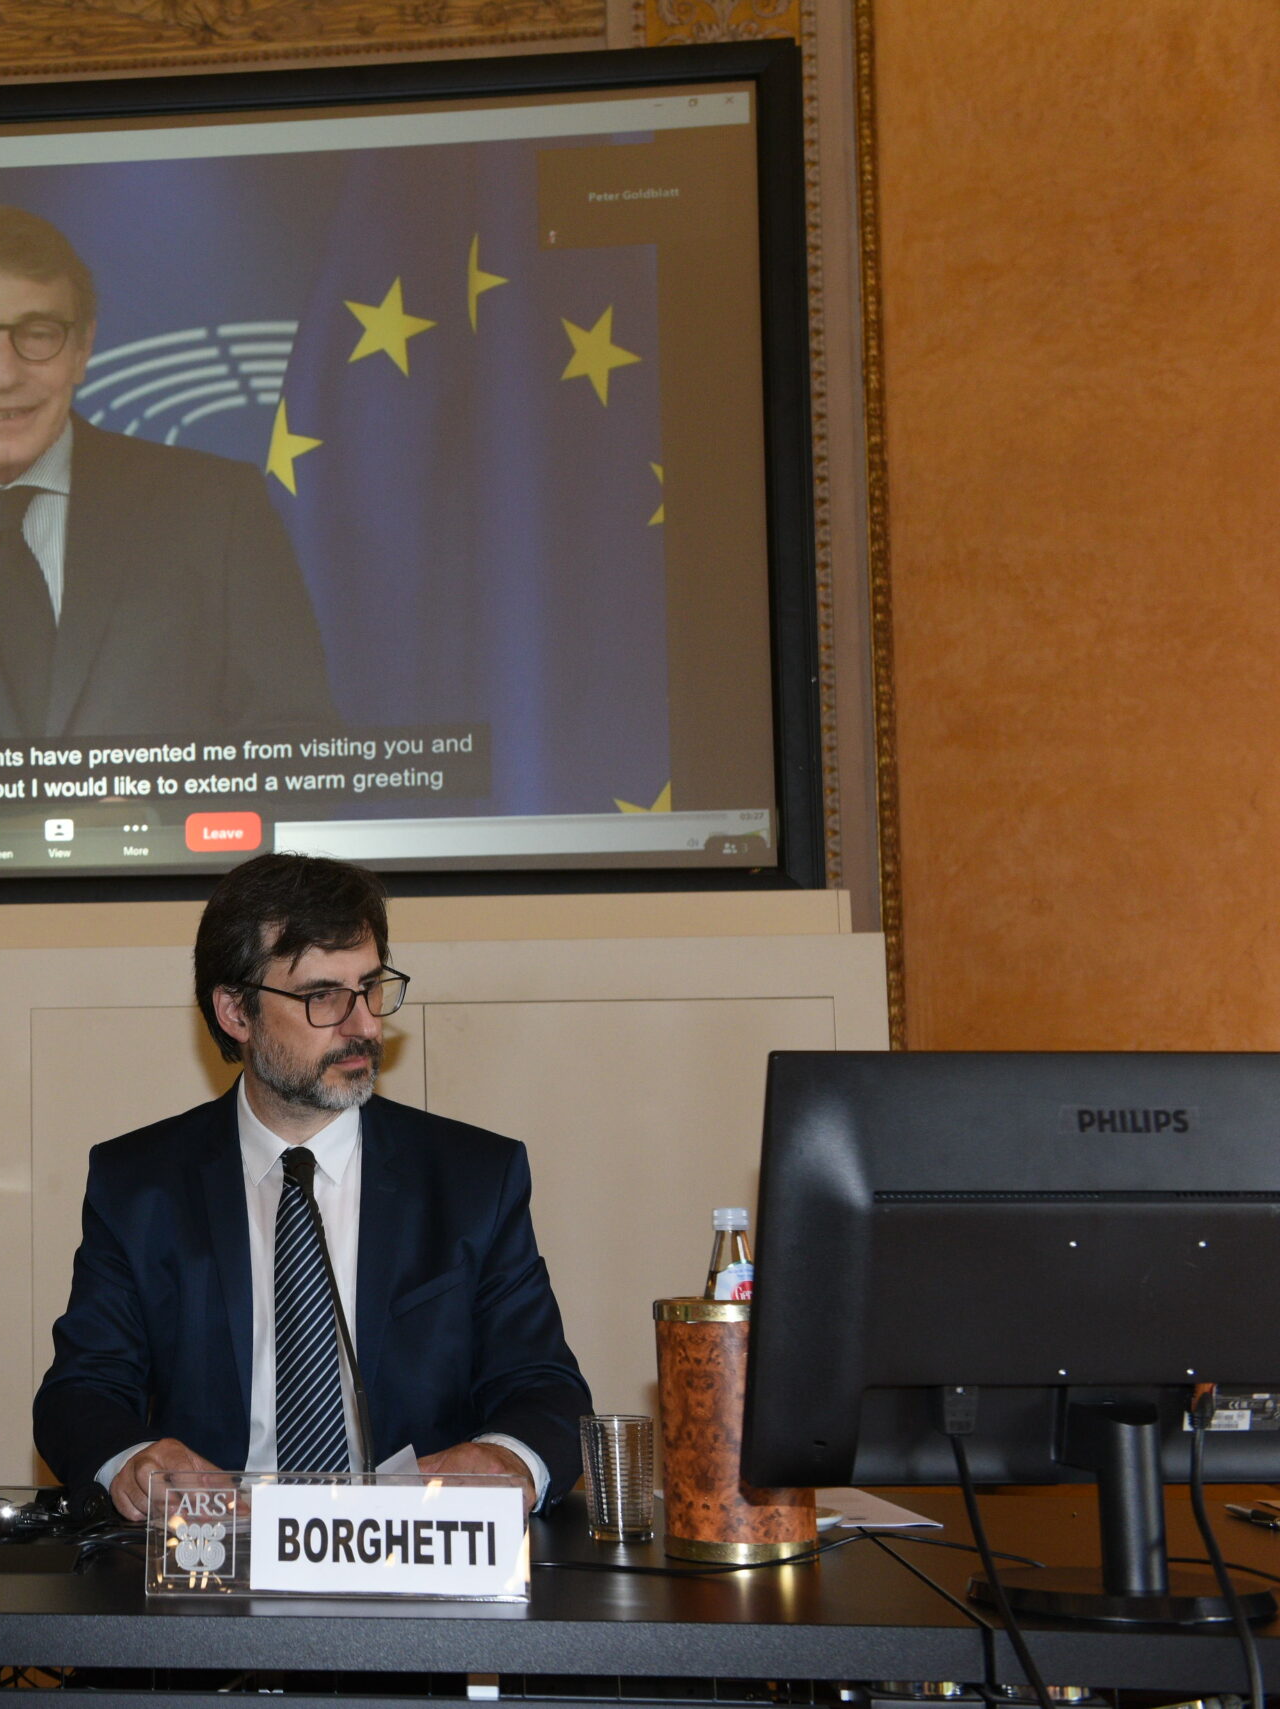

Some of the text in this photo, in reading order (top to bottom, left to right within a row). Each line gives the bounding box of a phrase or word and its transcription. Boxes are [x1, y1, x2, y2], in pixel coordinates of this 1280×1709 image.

[588, 187, 680, 202] Peter Goldblatt
[30, 746, 83, 766] have
[89, 742, 196, 769] prevented
[203, 745, 236, 761] me
[243, 740, 292, 759] from
[300, 737, 376, 761] visiting
[384, 739, 424, 759] you
[432, 734, 473, 753] and
[31, 778, 38, 797] I
[45, 776, 107, 797] would
[114, 775, 151, 795] like
[157, 777, 178, 794] to
[184, 773, 257, 793] extend
[265, 776, 278, 791] a
[285, 773, 345, 790] warm
[353, 769, 444, 793] greeting
[202, 826, 244, 840] Leave
[47, 847, 71, 858] View
[123, 845, 149, 856] More
[1077, 1109, 1189, 1133] PHILIPS
[176, 1493, 227, 1517] ARS
[278, 1517, 496, 1566] BORGHETTI
